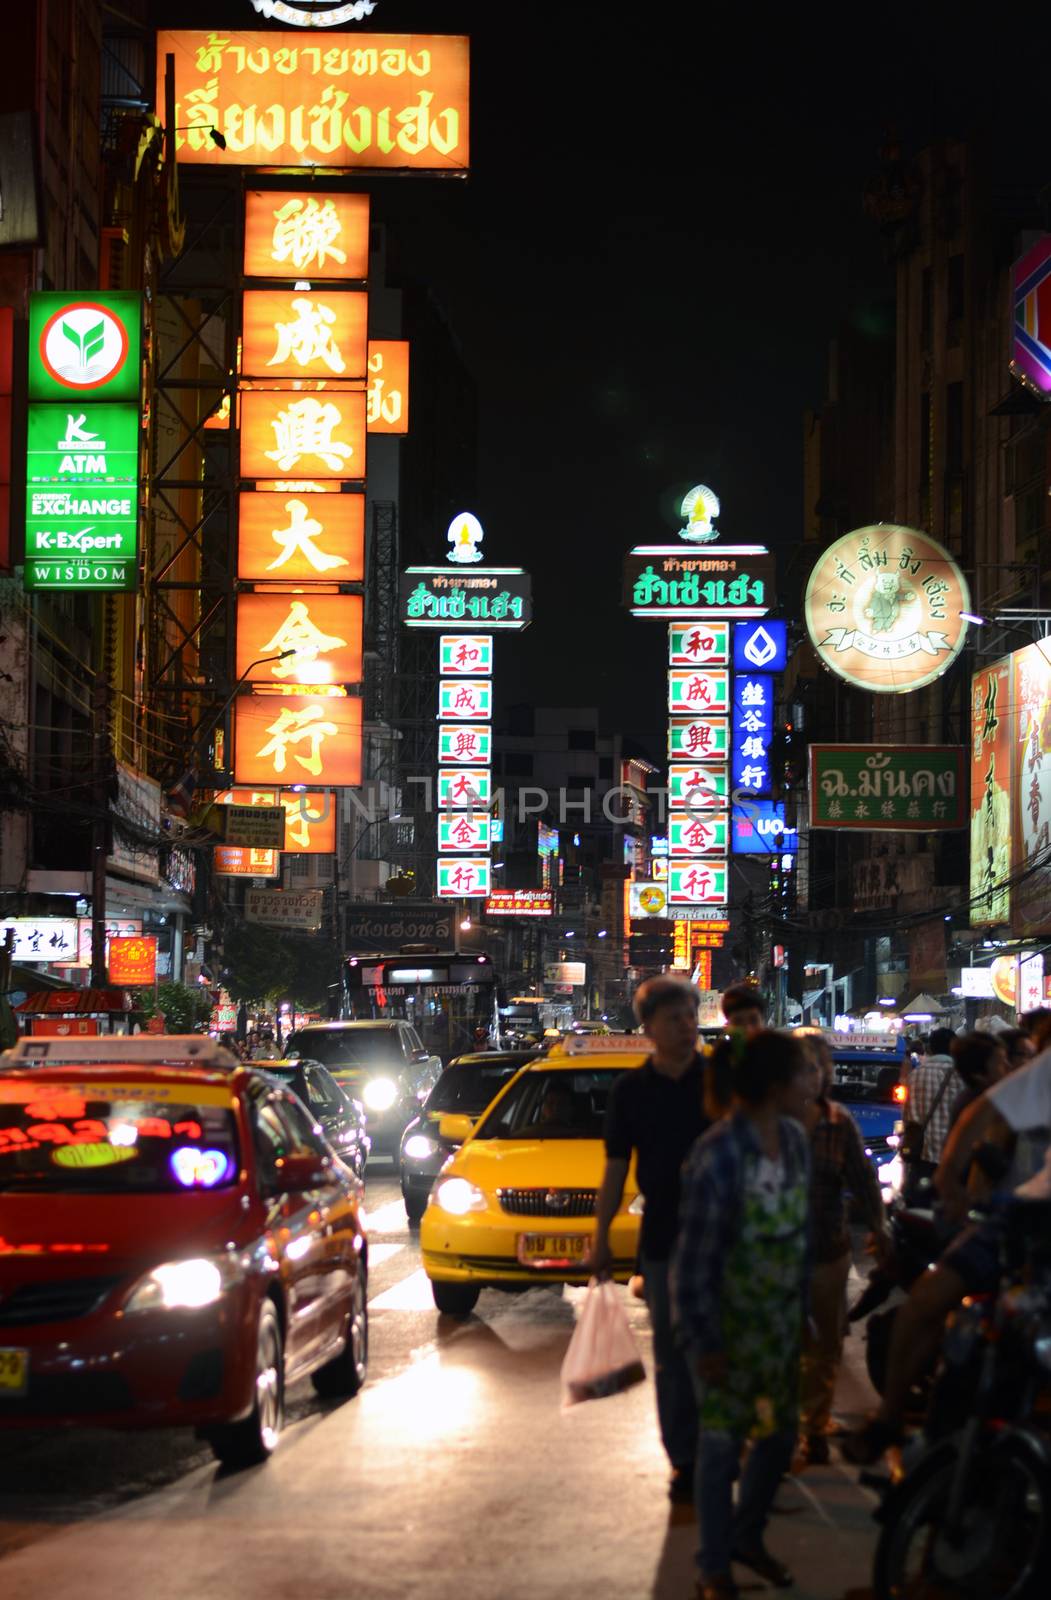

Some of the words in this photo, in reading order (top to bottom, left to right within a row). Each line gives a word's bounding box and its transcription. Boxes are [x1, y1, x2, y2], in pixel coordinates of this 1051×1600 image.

[195, 33, 431, 77] ห้างขายทอง
[58, 455, 107, 473] ATM
[32, 500, 131, 515] EXCHANGE
[36, 526, 123, 553] K-Expert
[34, 568, 126, 579] WISDOM
[662, 556, 737, 571] ห้างขายทอง
[451, 643, 479, 892] 和成興大金行
[684, 630, 714, 898] 和成興大金行
[820, 751, 956, 798] ฉ.มั่นคง
